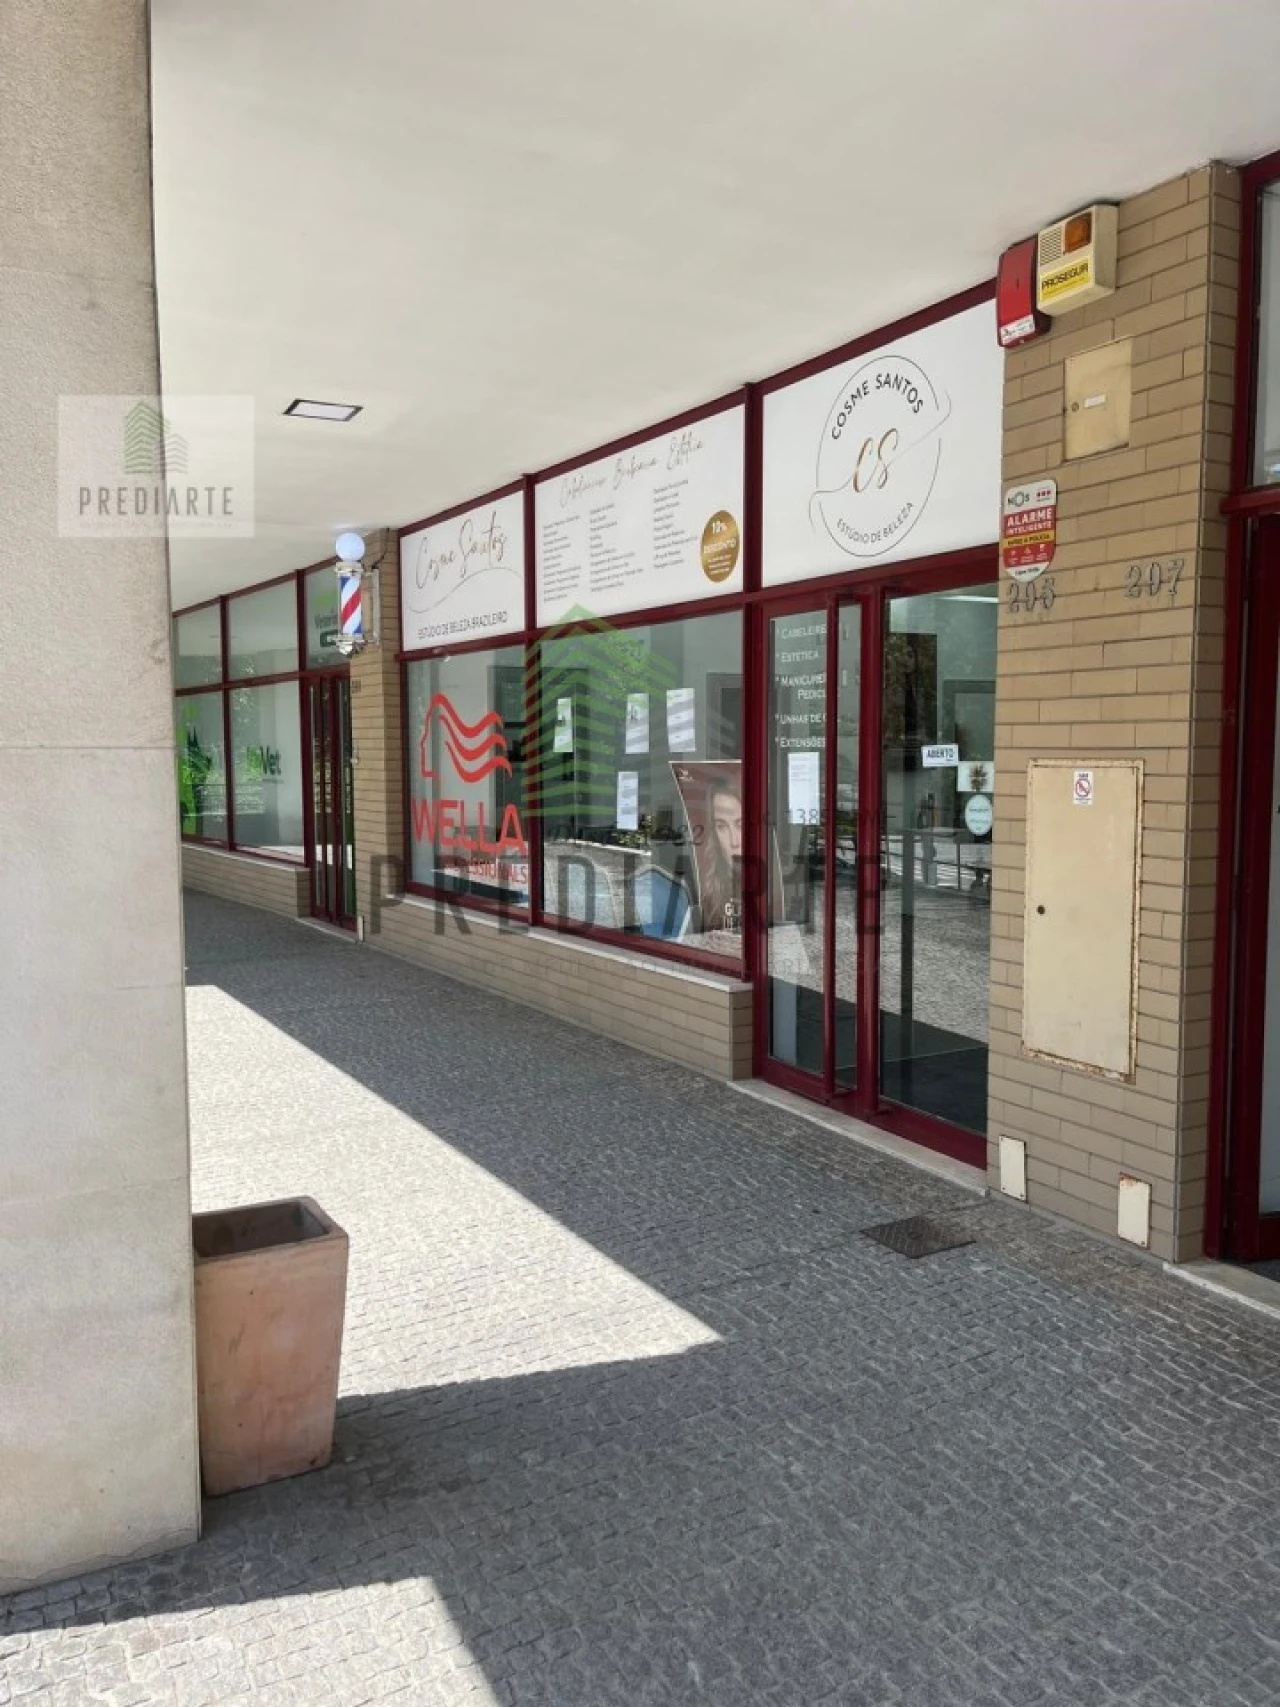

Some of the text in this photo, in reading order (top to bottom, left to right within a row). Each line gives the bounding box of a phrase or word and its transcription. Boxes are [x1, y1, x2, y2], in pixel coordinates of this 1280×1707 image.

[1041, 262, 1089, 291] PROSEGUR
[831, 372, 924, 440] COSME SANTOS
[870, 529, 882, 543] DE
[883, 502, 914, 538] BELEZA
[1007, 507, 1052, 528] ALARME
[1125, 557, 1185, 600] 207
[926, 748, 954, 759] ABERTO
[411, 798, 528, 857] WELLA
